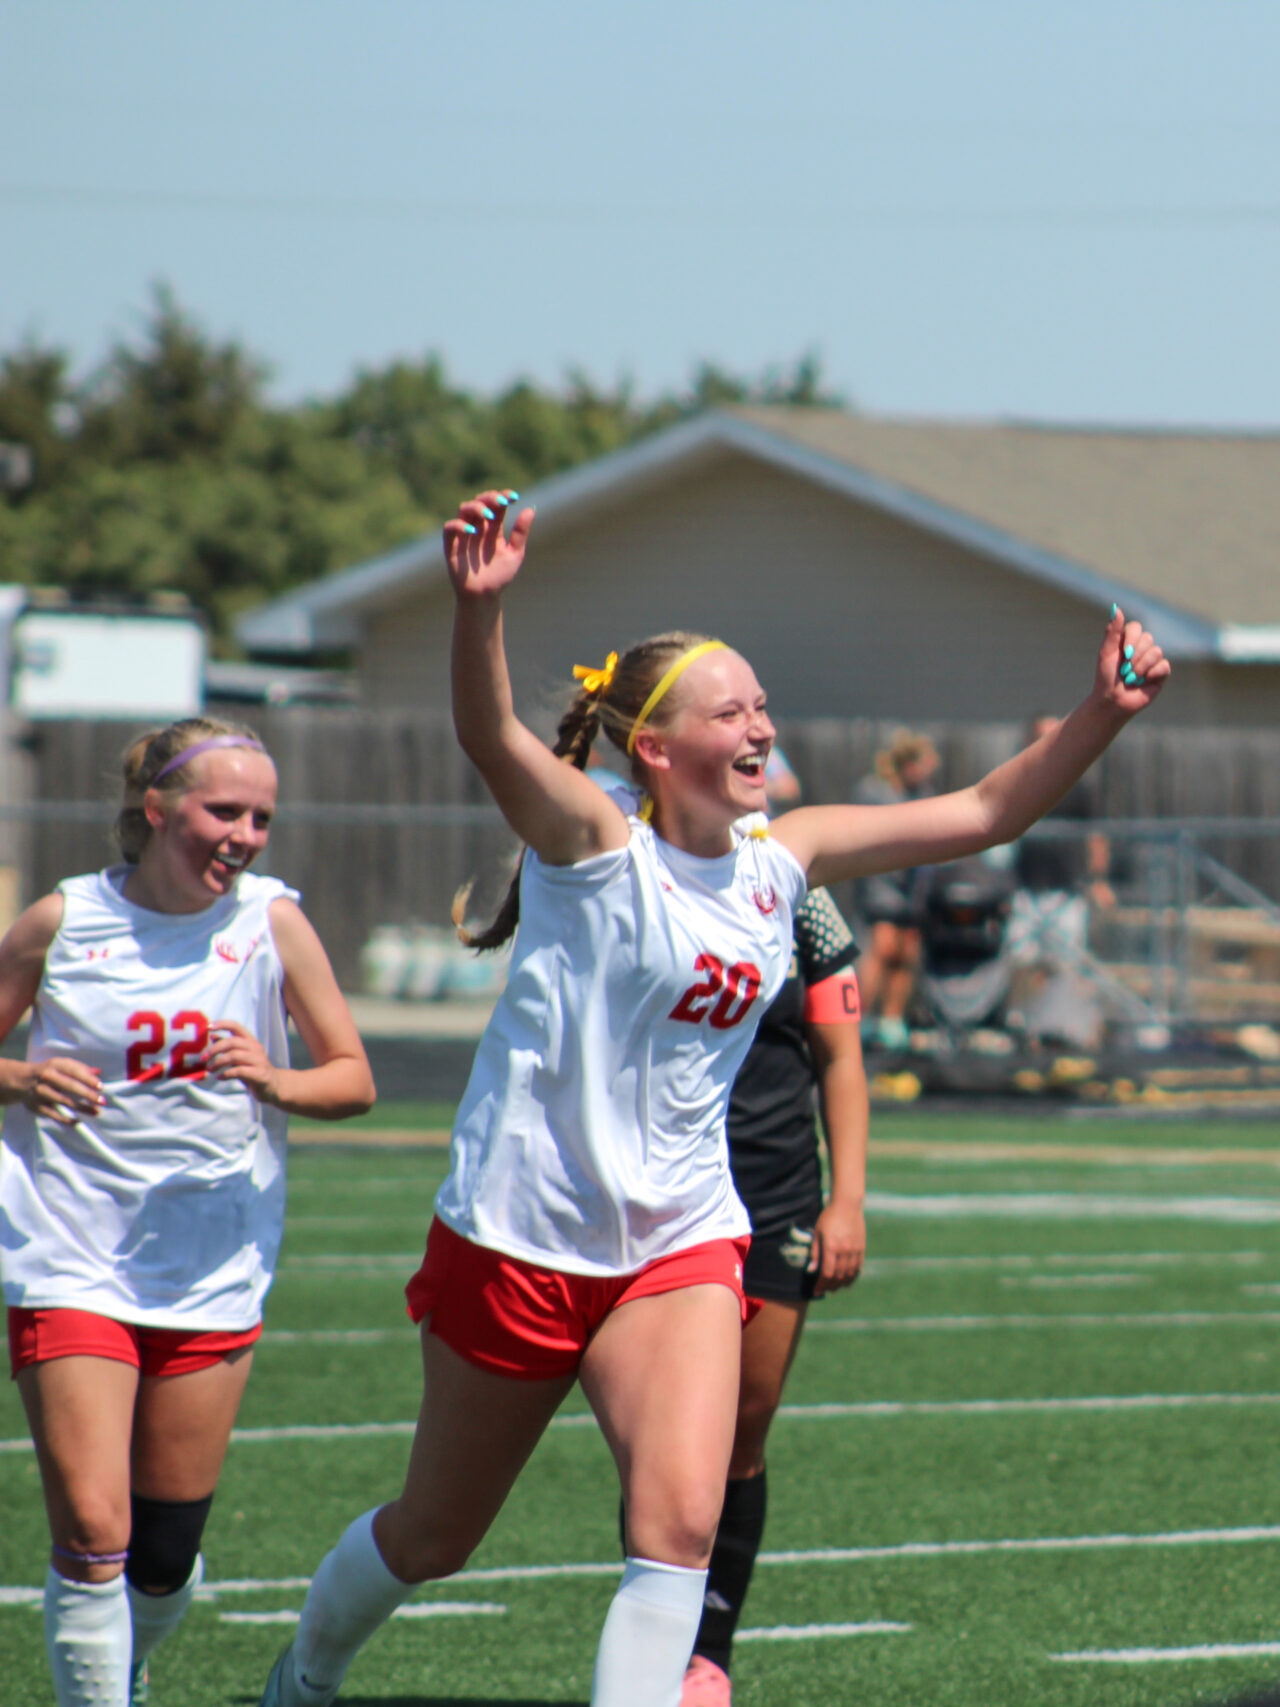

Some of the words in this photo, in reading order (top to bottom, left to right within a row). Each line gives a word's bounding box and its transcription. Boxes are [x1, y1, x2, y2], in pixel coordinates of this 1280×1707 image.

[669, 952, 761, 1030] 20
[842, 983, 858, 1014] C
[126, 1010, 208, 1083] 22
